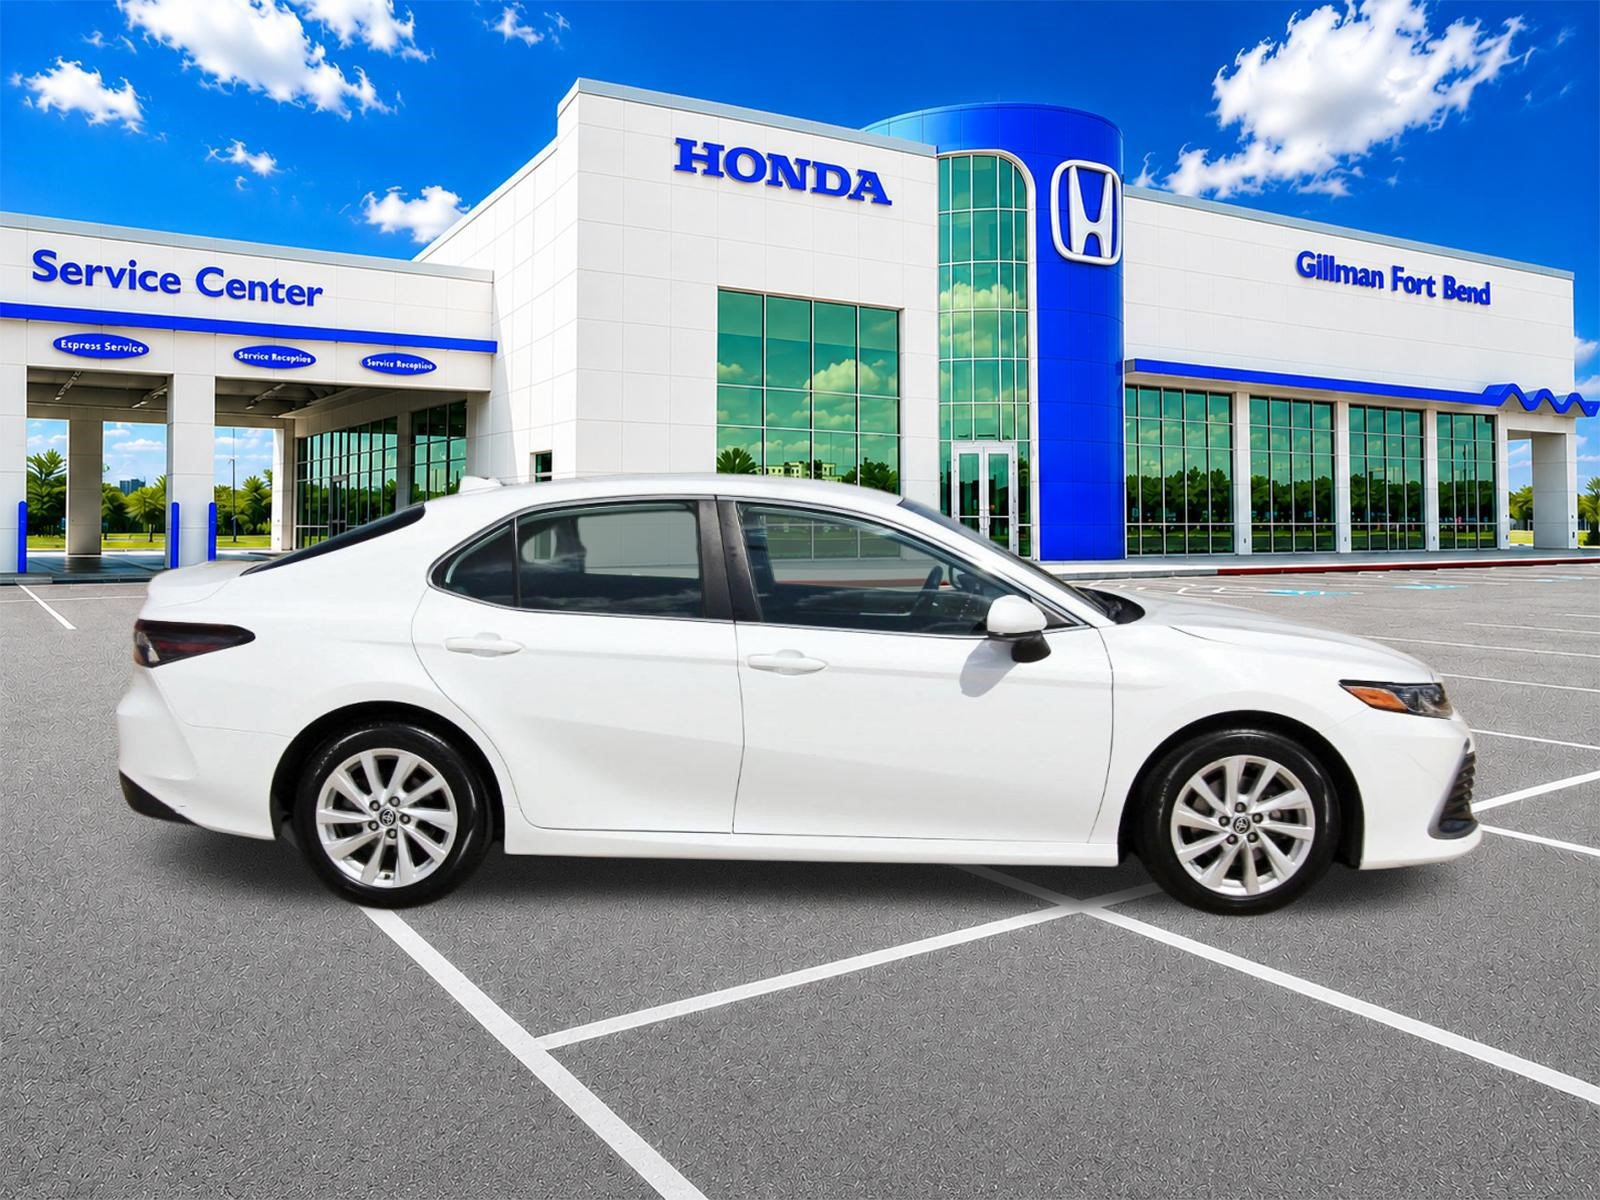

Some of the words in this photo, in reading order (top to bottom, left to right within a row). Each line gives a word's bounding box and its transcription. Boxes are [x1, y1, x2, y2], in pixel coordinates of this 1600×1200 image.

[674, 137, 892, 206] HONDA
[32, 249, 181, 294] Service
[195, 266, 323, 307] Center
[1296, 250, 1385, 289] Gillman
[1391, 265, 1437, 298] Fort
[1442, 275, 1491, 305] Bend
[60, 339, 101, 352] Express
[104, 342, 144, 354] Service
[238, 351, 270, 361] Service
[367, 358, 395, 368] Service
